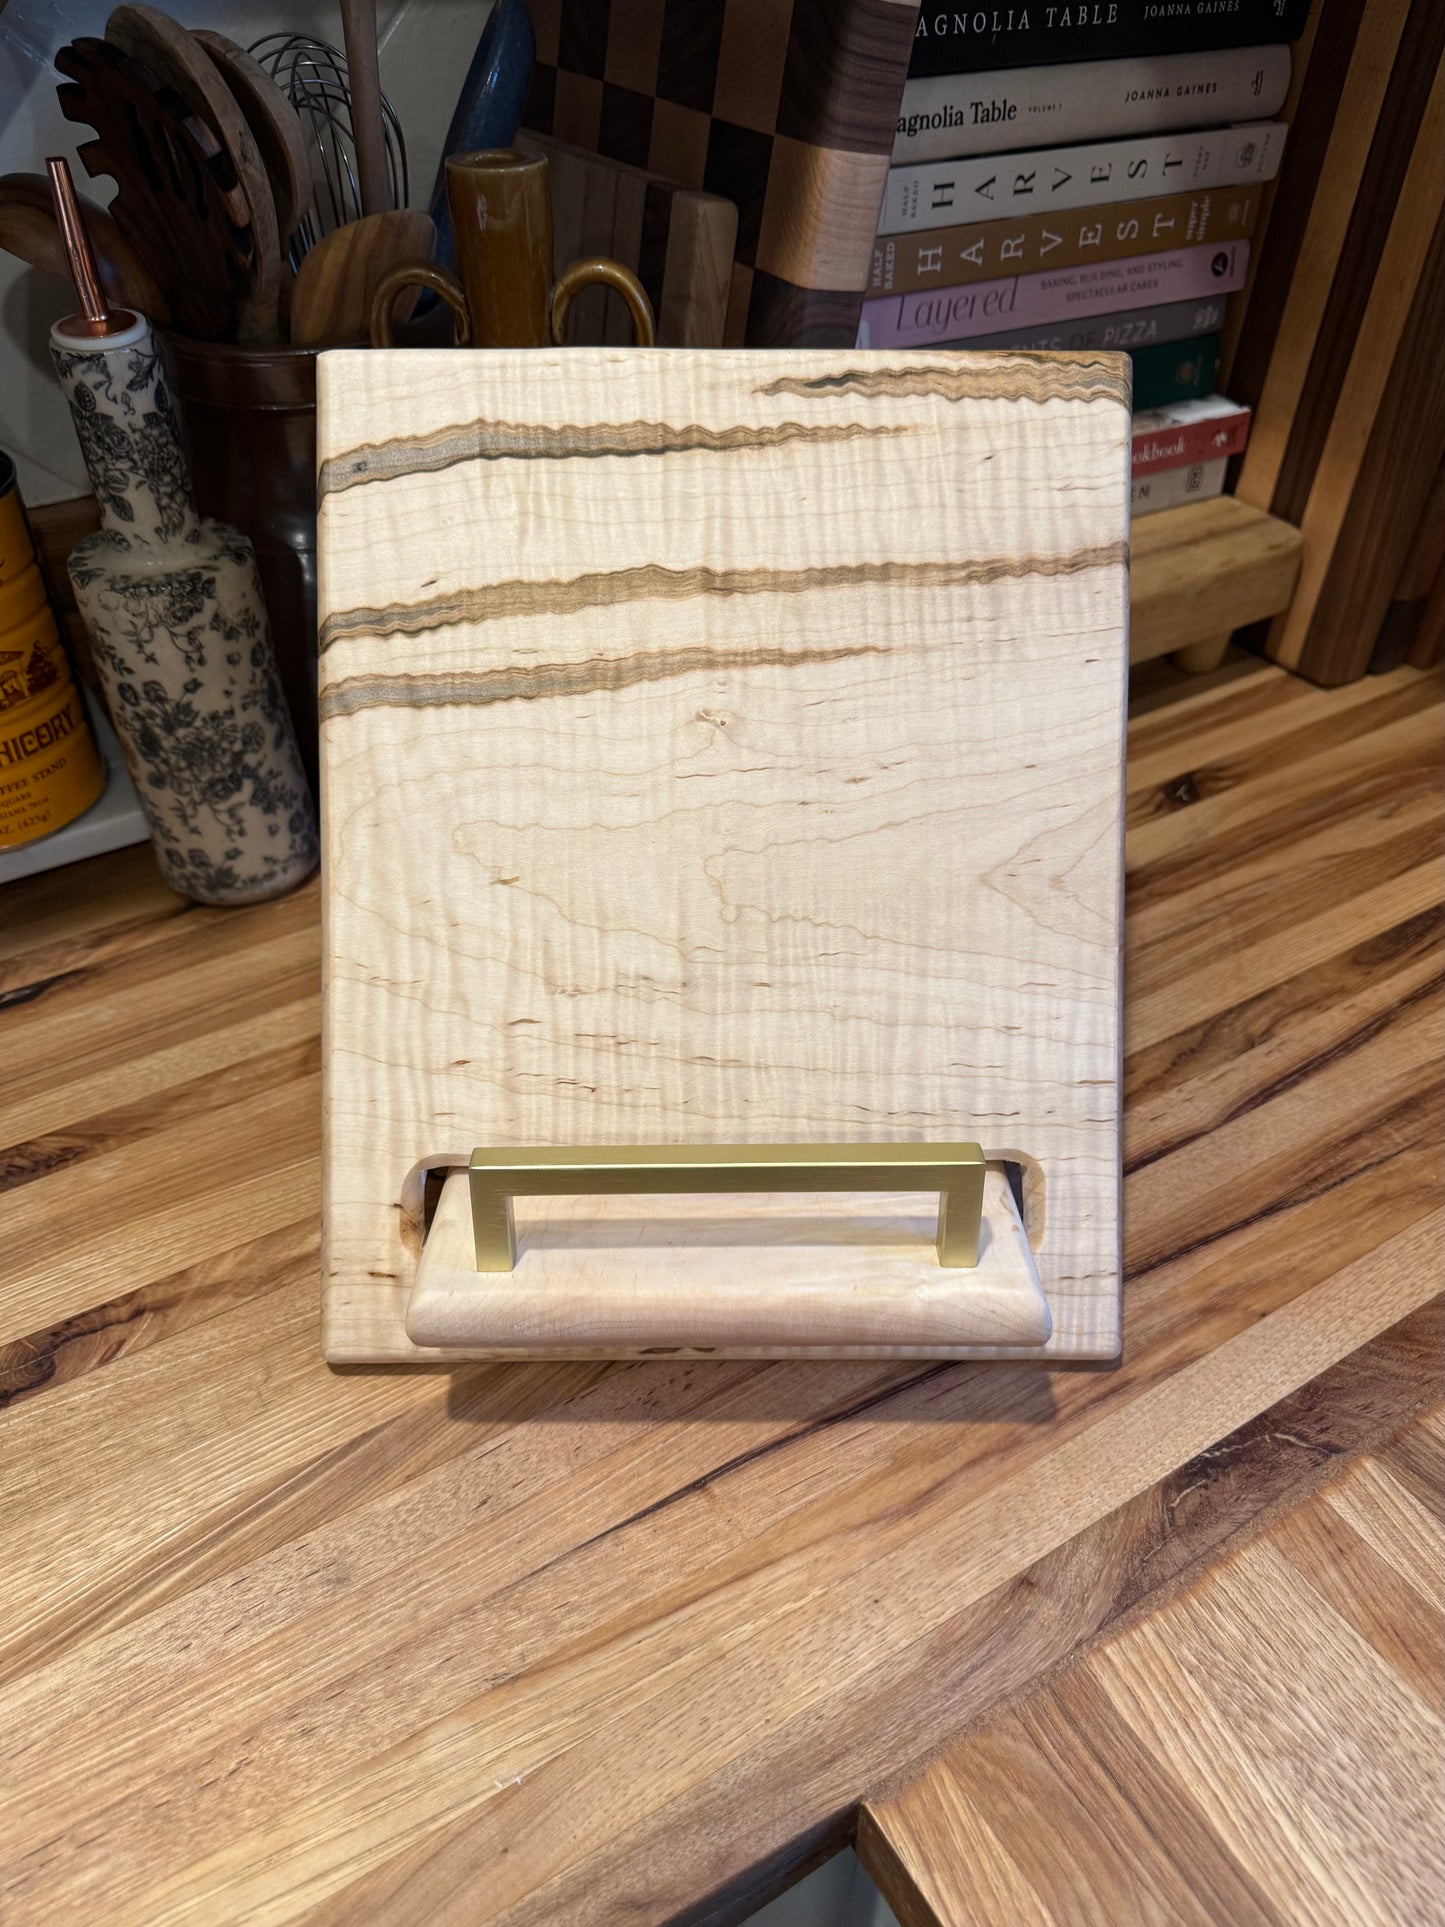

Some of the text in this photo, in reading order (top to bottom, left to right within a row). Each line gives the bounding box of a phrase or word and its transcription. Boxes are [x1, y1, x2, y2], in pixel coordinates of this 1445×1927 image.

[914, 3, 1118, 38] AGNOLIA TABLE
[1143, 0, 1240, 20] JOANNA GAINES
[1125, 82, 1218, 103] JOANNA GAINES
[896, 104, 964, 137] agnolia
[970, 98, 1017, 125] Table
[931, 153, 1183, 210] HARVEST
[917, 212, 1176, 275] HARVEST
[872, 248, 883, 288] HALF
[884, 241, 897, 290] BAKED
[1127, 263, 1145, 275] AND
[1147, 258, 1184, 272] STYLING
[896, 275, 1019, 335] Layered
[1066, 279, 1158, 302] SPECTACULAR CAKES
[1102, 317, 1159, 347] PIZZA
[32, 757, 67, 783] STAND
